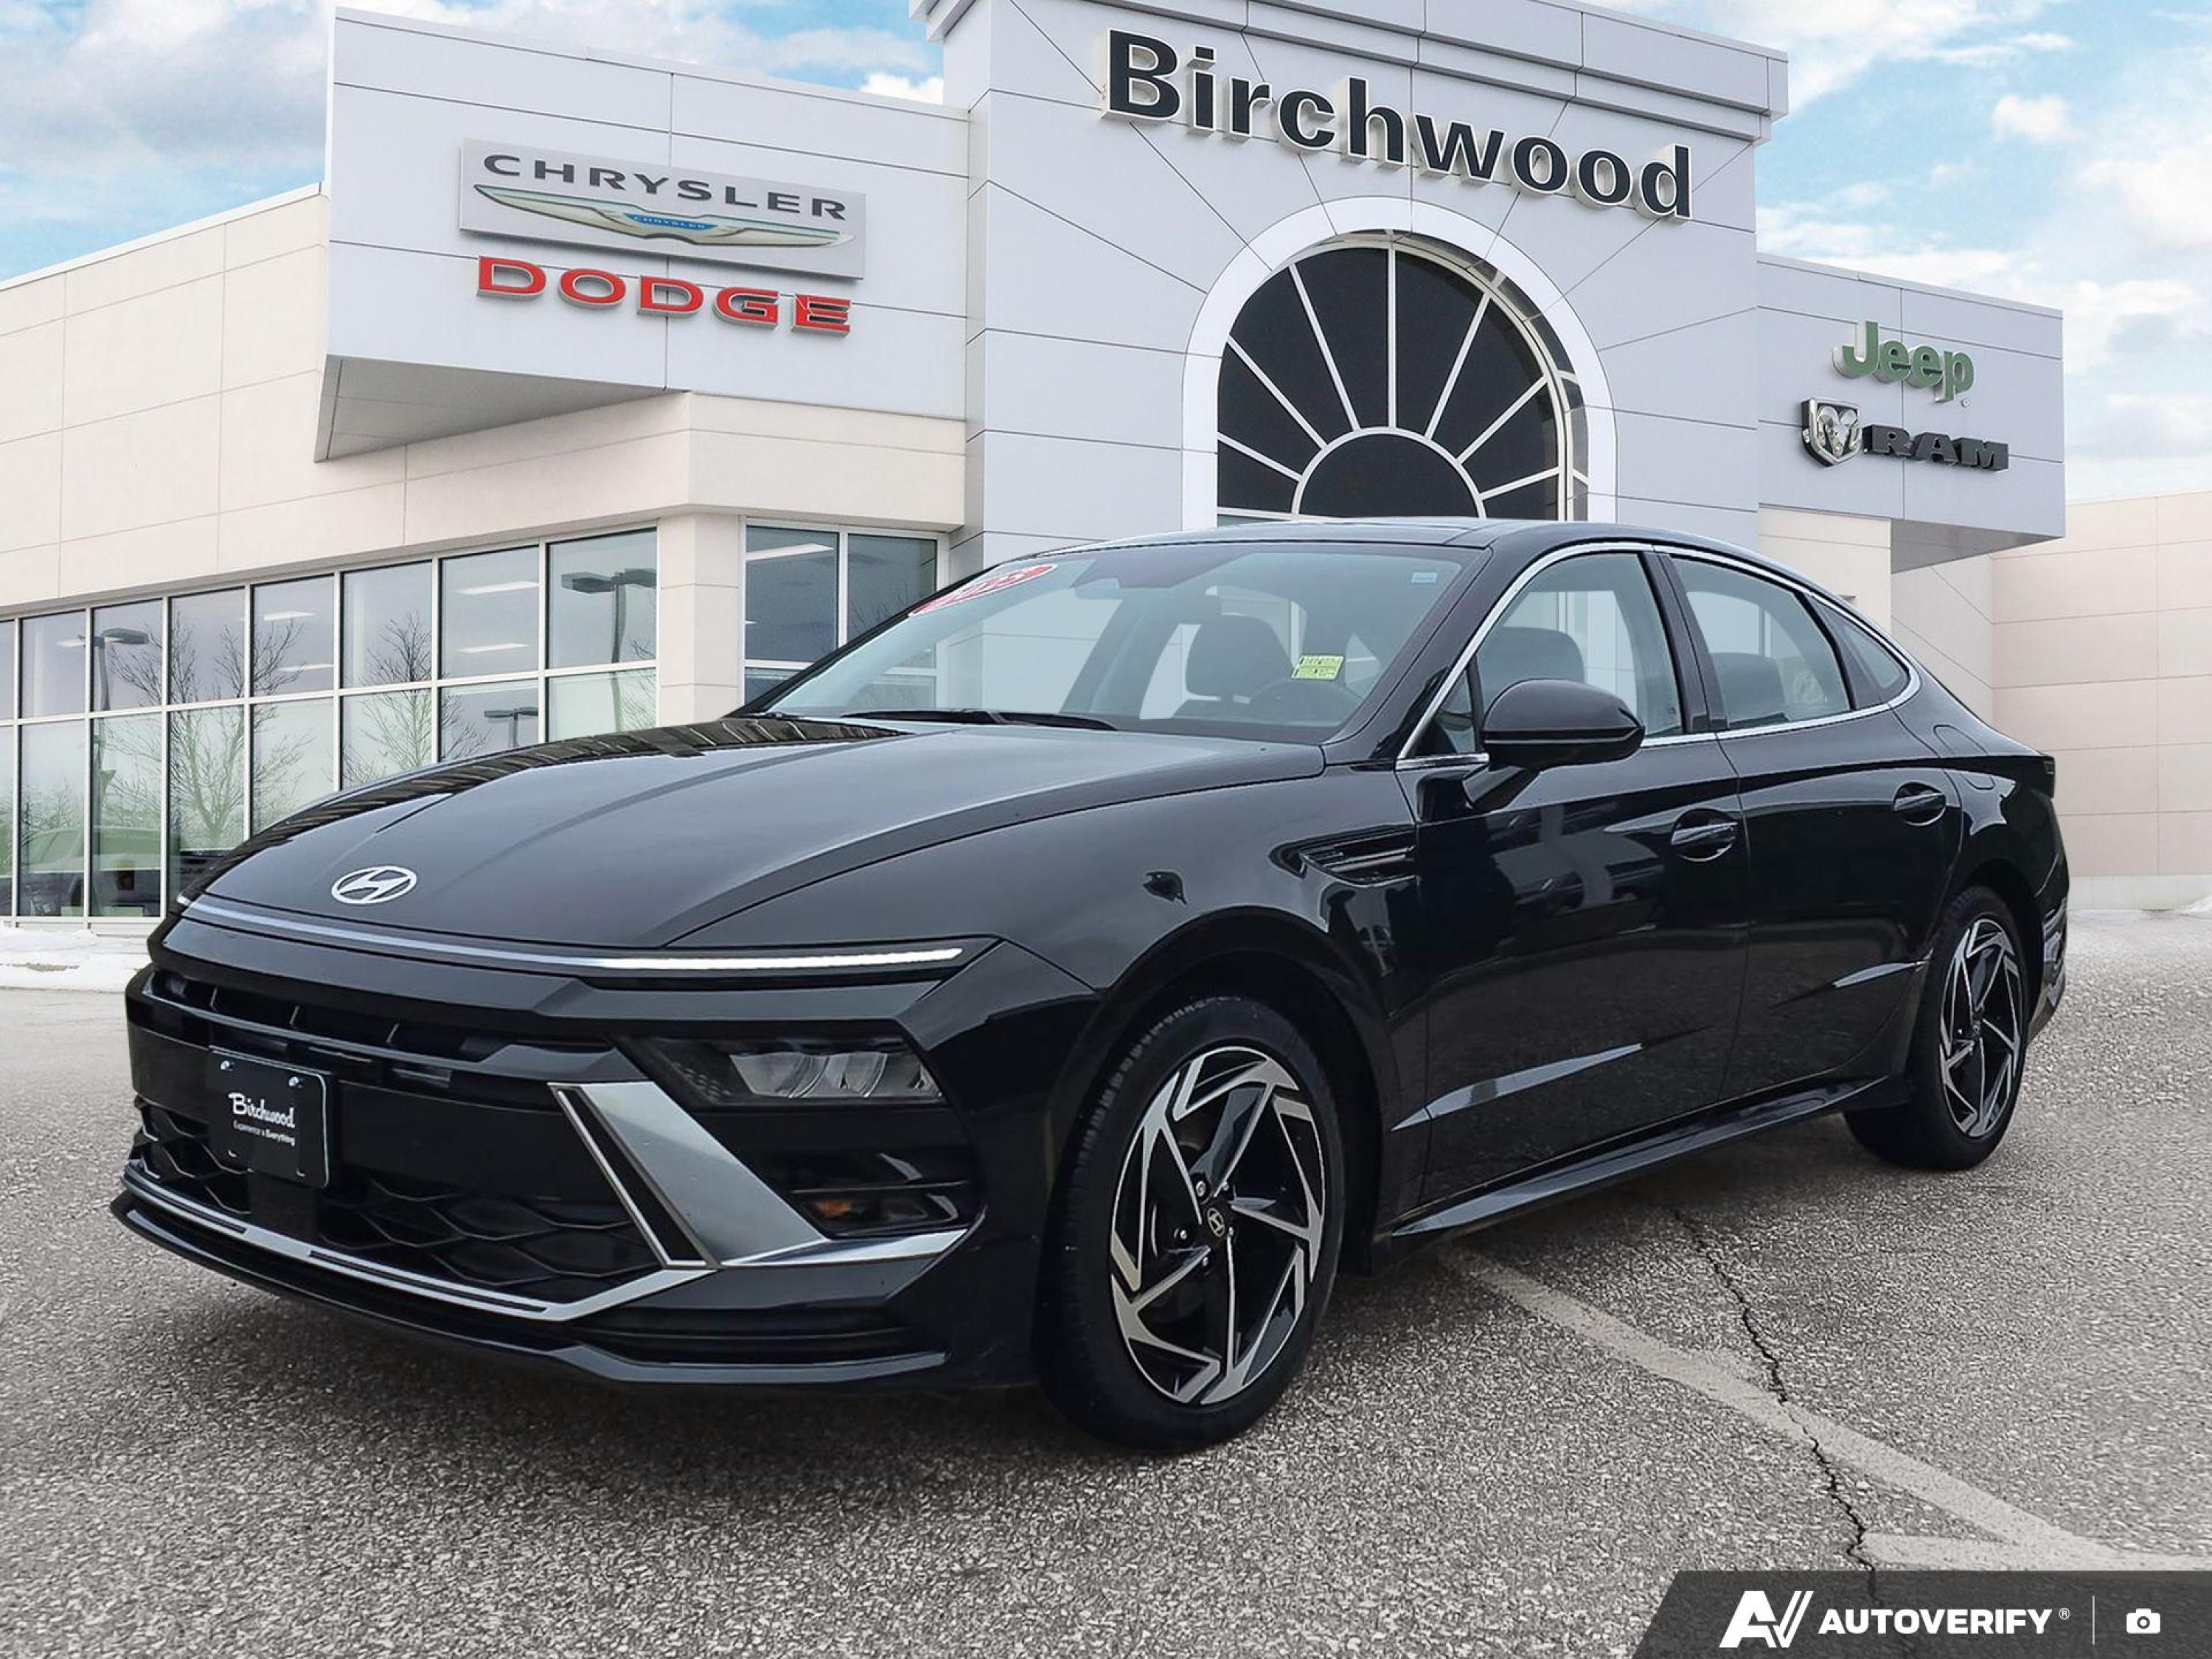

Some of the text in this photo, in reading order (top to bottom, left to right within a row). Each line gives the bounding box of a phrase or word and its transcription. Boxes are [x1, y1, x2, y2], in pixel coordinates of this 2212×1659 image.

[1101, 28, 1693, 220] Birchwood
[484, 155, 846, 220] CHRYSLER
[477, 255, 851, 337] DODGE
[1832, 320, 1975, 403] Jeep
[1862, 425, 2009, 471] RAM
[228, 1092, 295, 1128] Birchwood
